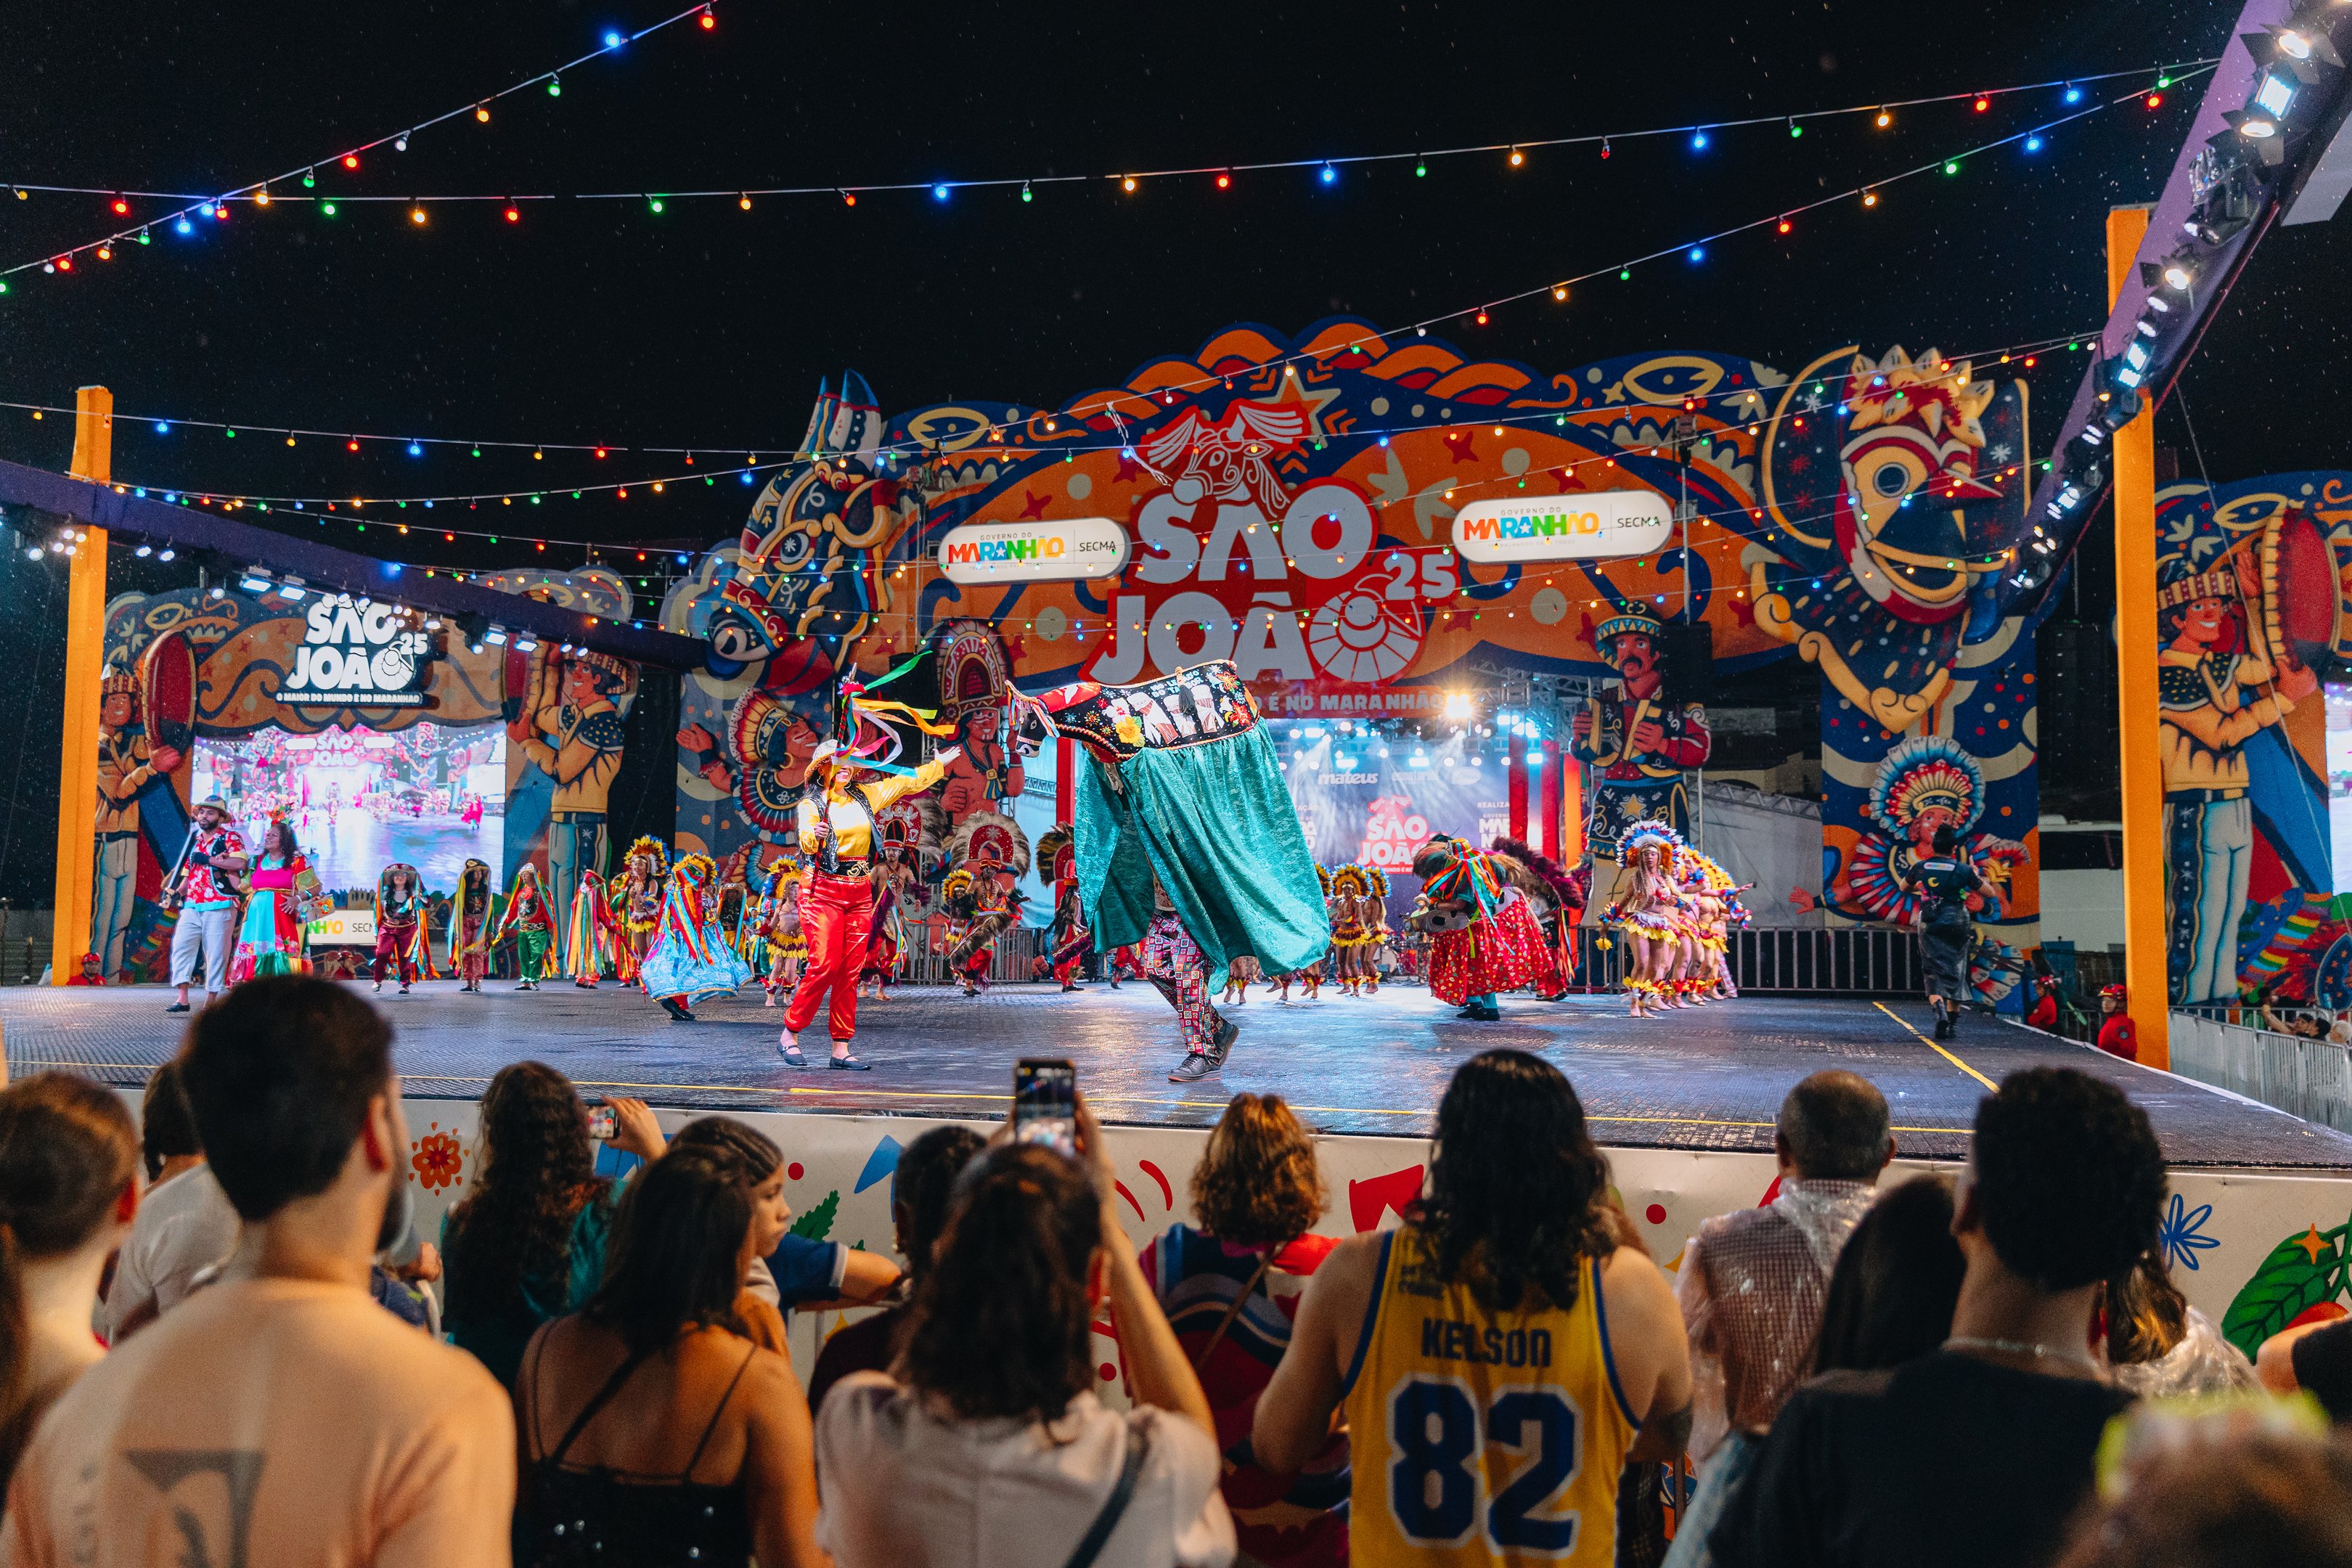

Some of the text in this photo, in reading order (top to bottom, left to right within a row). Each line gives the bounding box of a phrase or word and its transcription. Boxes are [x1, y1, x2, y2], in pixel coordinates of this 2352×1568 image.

[1135, 481, 1373, 584] SÃO
[1463, 510, 1600, 541] MARANHÃO
[948, 536, 1065, 563] MARANHÃO
[1079, 541, 1116, 552] SECMA
[1384, 553, 1456, 600] 25
[399, 632, 428, 655] 25
[1090, 589, 1423, 684] JOÃO
[285, 645, 415, 690] JOÃO
[284, 693, 310, 702] MAIOR
[311, 693, 322, 702] DO
[323, 693, 354, 703] MUNDO
[360, 693, 372, 703] NO
[1269, 692, 1279, 711] É
[1286, 695, 1313, 711] NO
[1318, 772, 1379, 785] mateus
[1386, 1372, 1584, 1560] 82
